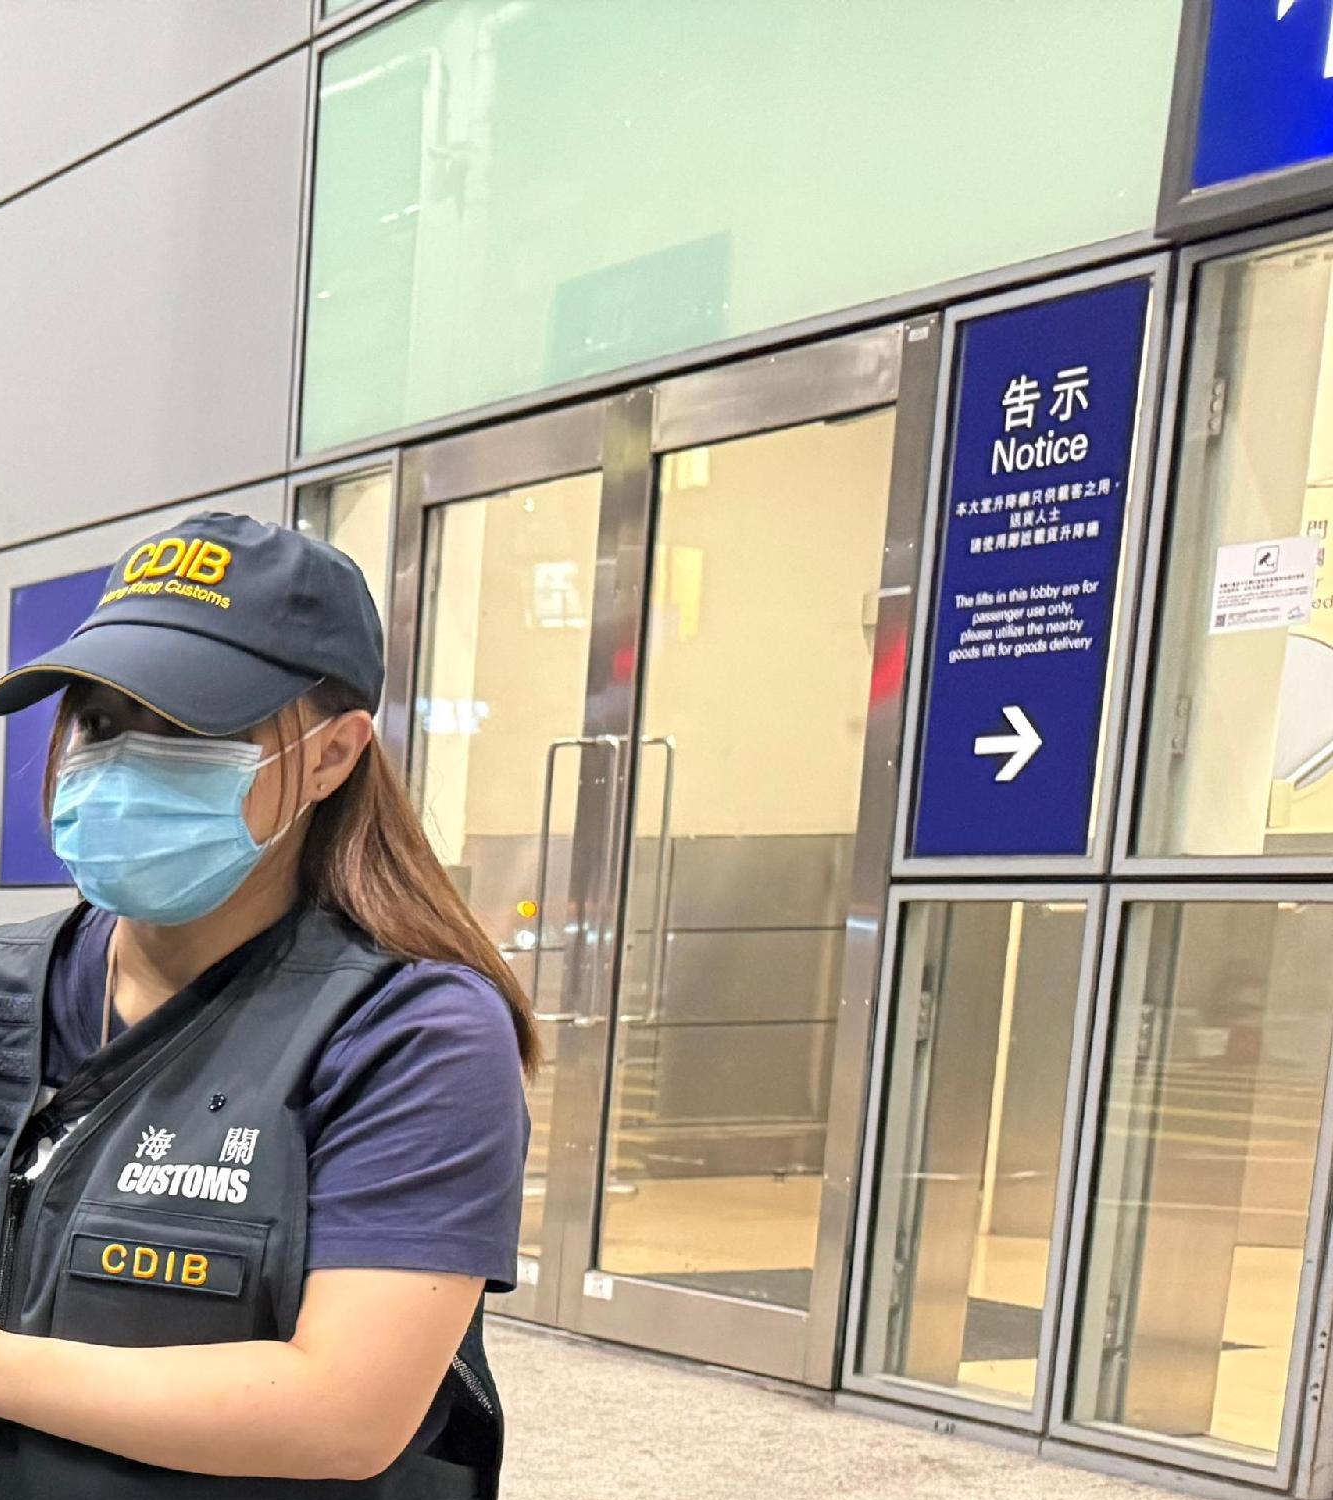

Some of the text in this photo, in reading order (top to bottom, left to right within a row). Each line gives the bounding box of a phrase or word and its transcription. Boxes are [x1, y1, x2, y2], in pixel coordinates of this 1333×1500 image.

[1002, 365, 1089, 432] 告示
[991, 429, 1089, 475] Notice
[123, 537, 231, 584] CDIB
[164, 579, 231, 609] Customs
[955, 594, 975, 609] The
[996, 589, 1007, 603] in
[1009, 587, 1028, 602] this
[1030, 583, 1060, 600] lobby
[1062, 583, 1080, 596] are
[1082, 579, 1100, 594] for
[960, 618, 1085, 646] please utilize the nearby
[971, 606, 1025, 627] passenger
[1027, 605, 1046, 618] use
[948, 636, 1093, 664] goods lift for goods delivery
[135, 1125, 260, 1165] 海關
[117, 1162, 250, 1204] CUSTOMS
[101, 1243, 209, 1286] CDIB
